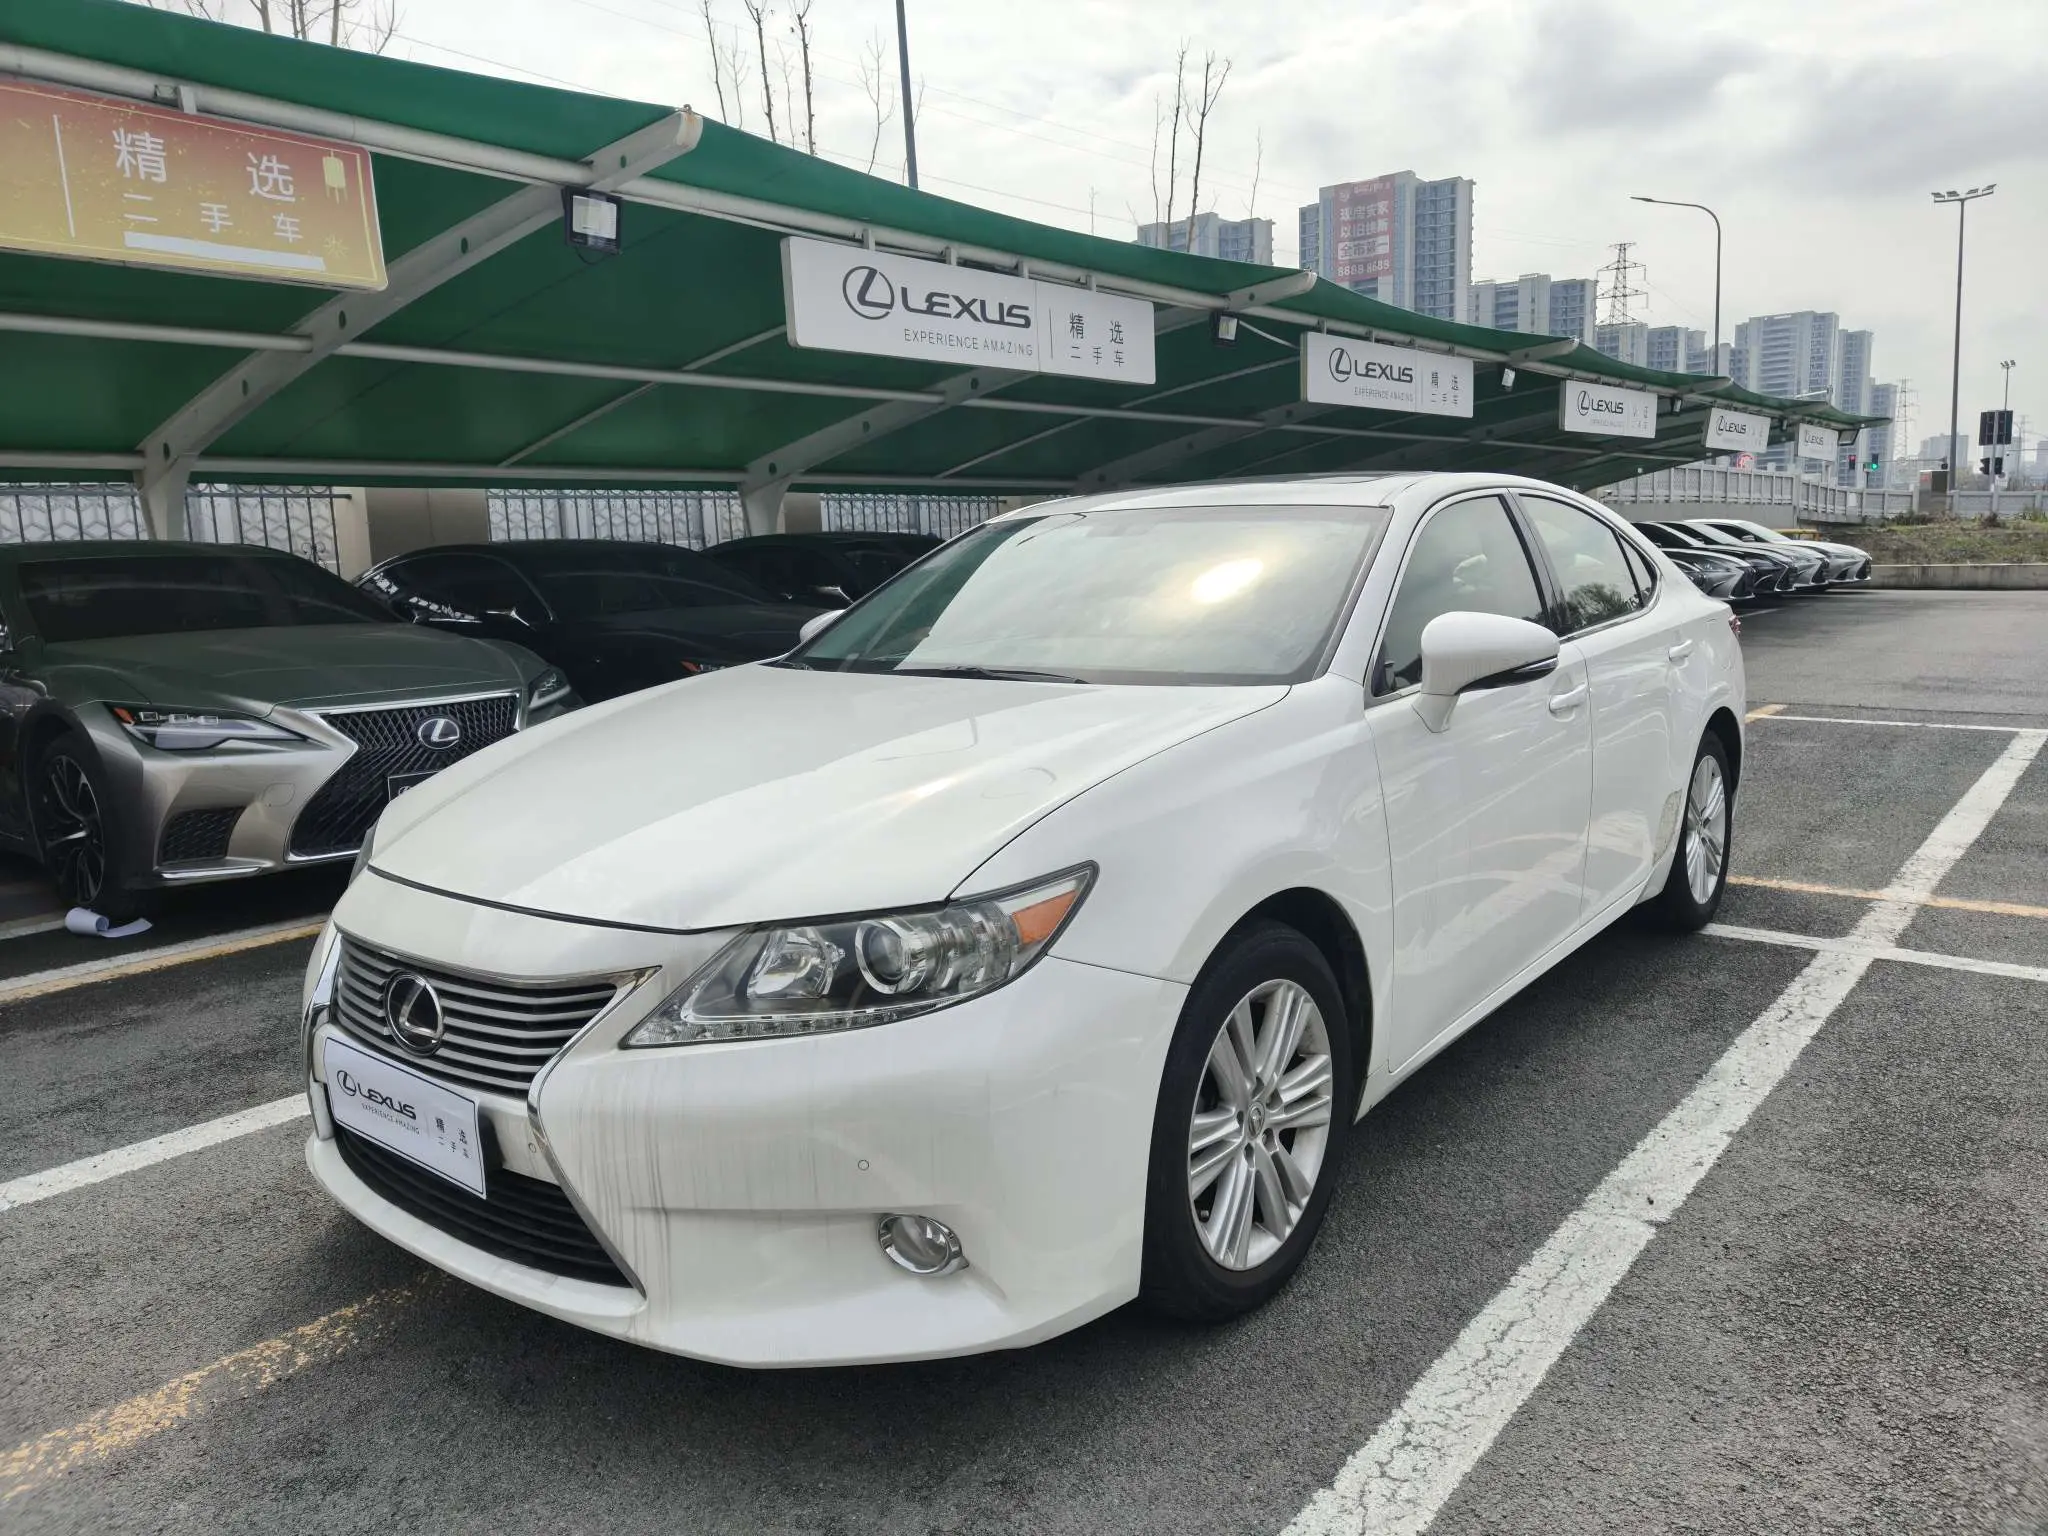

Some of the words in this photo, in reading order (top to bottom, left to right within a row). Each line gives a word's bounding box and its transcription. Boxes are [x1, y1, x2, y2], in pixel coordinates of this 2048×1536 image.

[112, 127, 296, 203] 精选
[123, 193, 303, 244] 二手车
[900, 286, 1032, 330] LEXUS
[904, 328, 979, 351] EXPERIENCE
[982, 338, 1034, 357] AMAZING
[1069, 313, 1125, 345] 精选
[1070, 346, 1126, 367] 二手车
[1354, 359, 1413, 383] LEXUS
[1590, 398, 1624, 414] LEXUS
[1725, 421, 1747, 434] LEXUS
[357, 1083, 417, 1121] LEXUS
[394, 1115, 420, 1136] AMAZING
